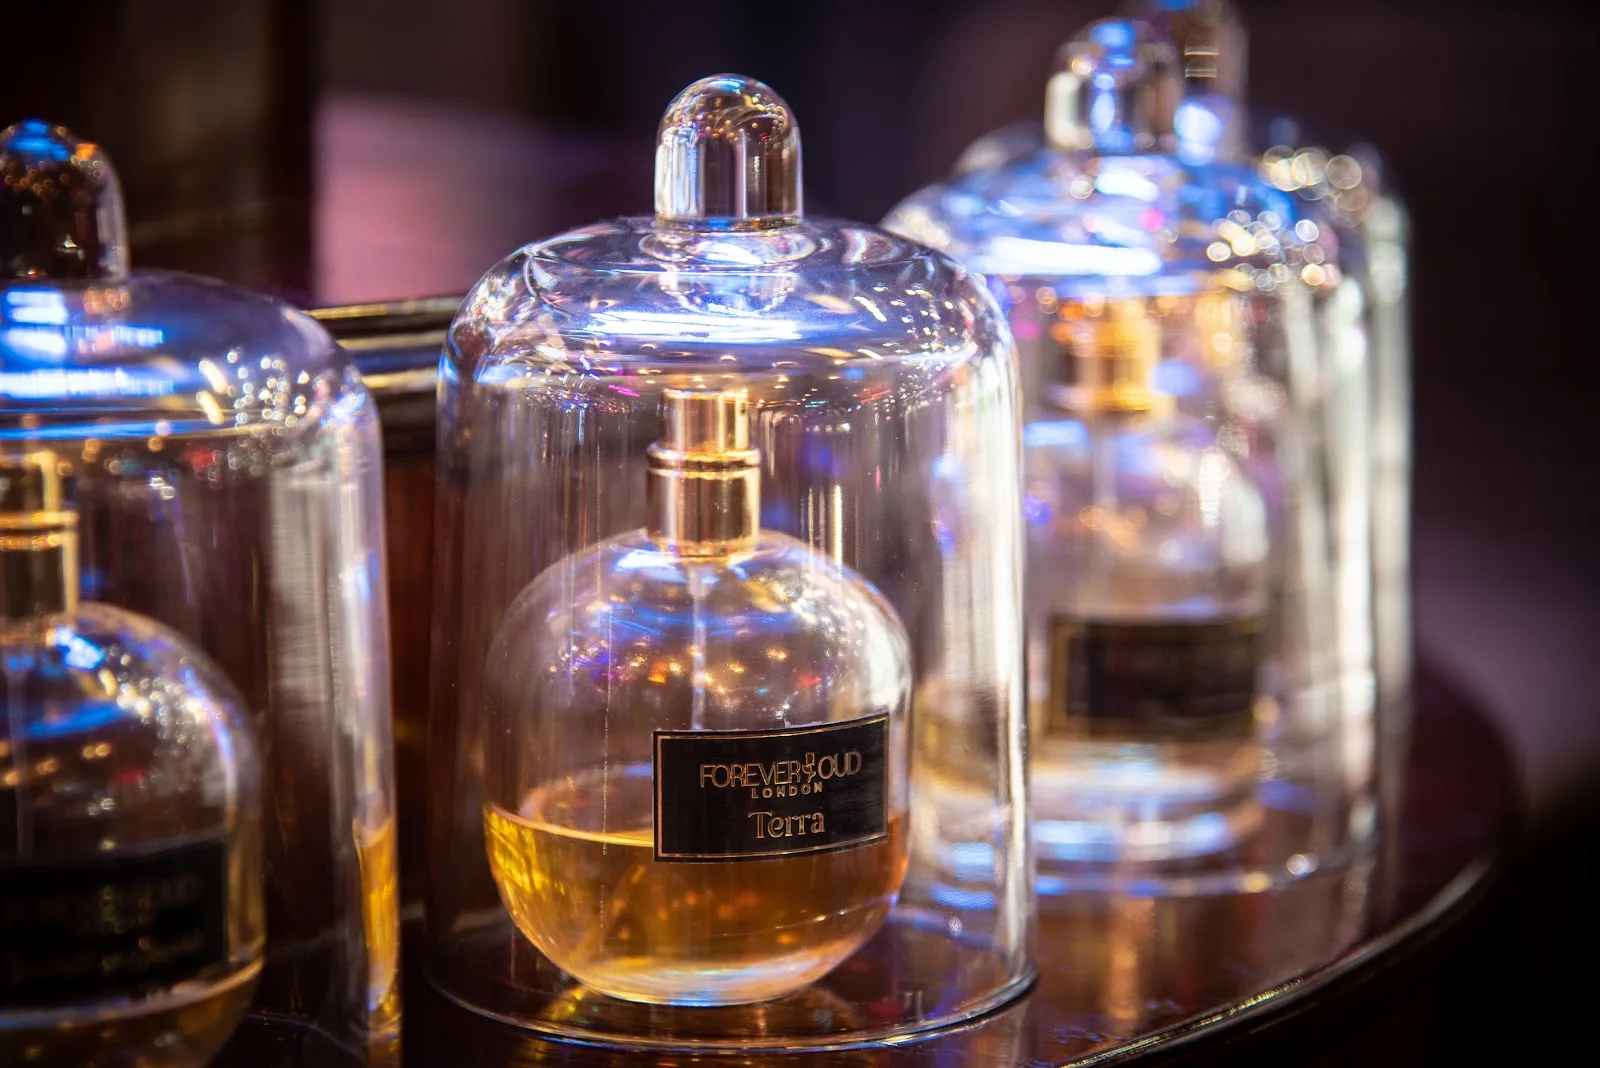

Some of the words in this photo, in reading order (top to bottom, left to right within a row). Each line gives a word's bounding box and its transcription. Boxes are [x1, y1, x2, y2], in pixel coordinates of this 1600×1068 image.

[700, 761, 800, 788] FOREVER
[818, 751, 862, 780] OUD
[751, 782, 823, 799] LONDON
[748, 811, 825, 839] Terra
